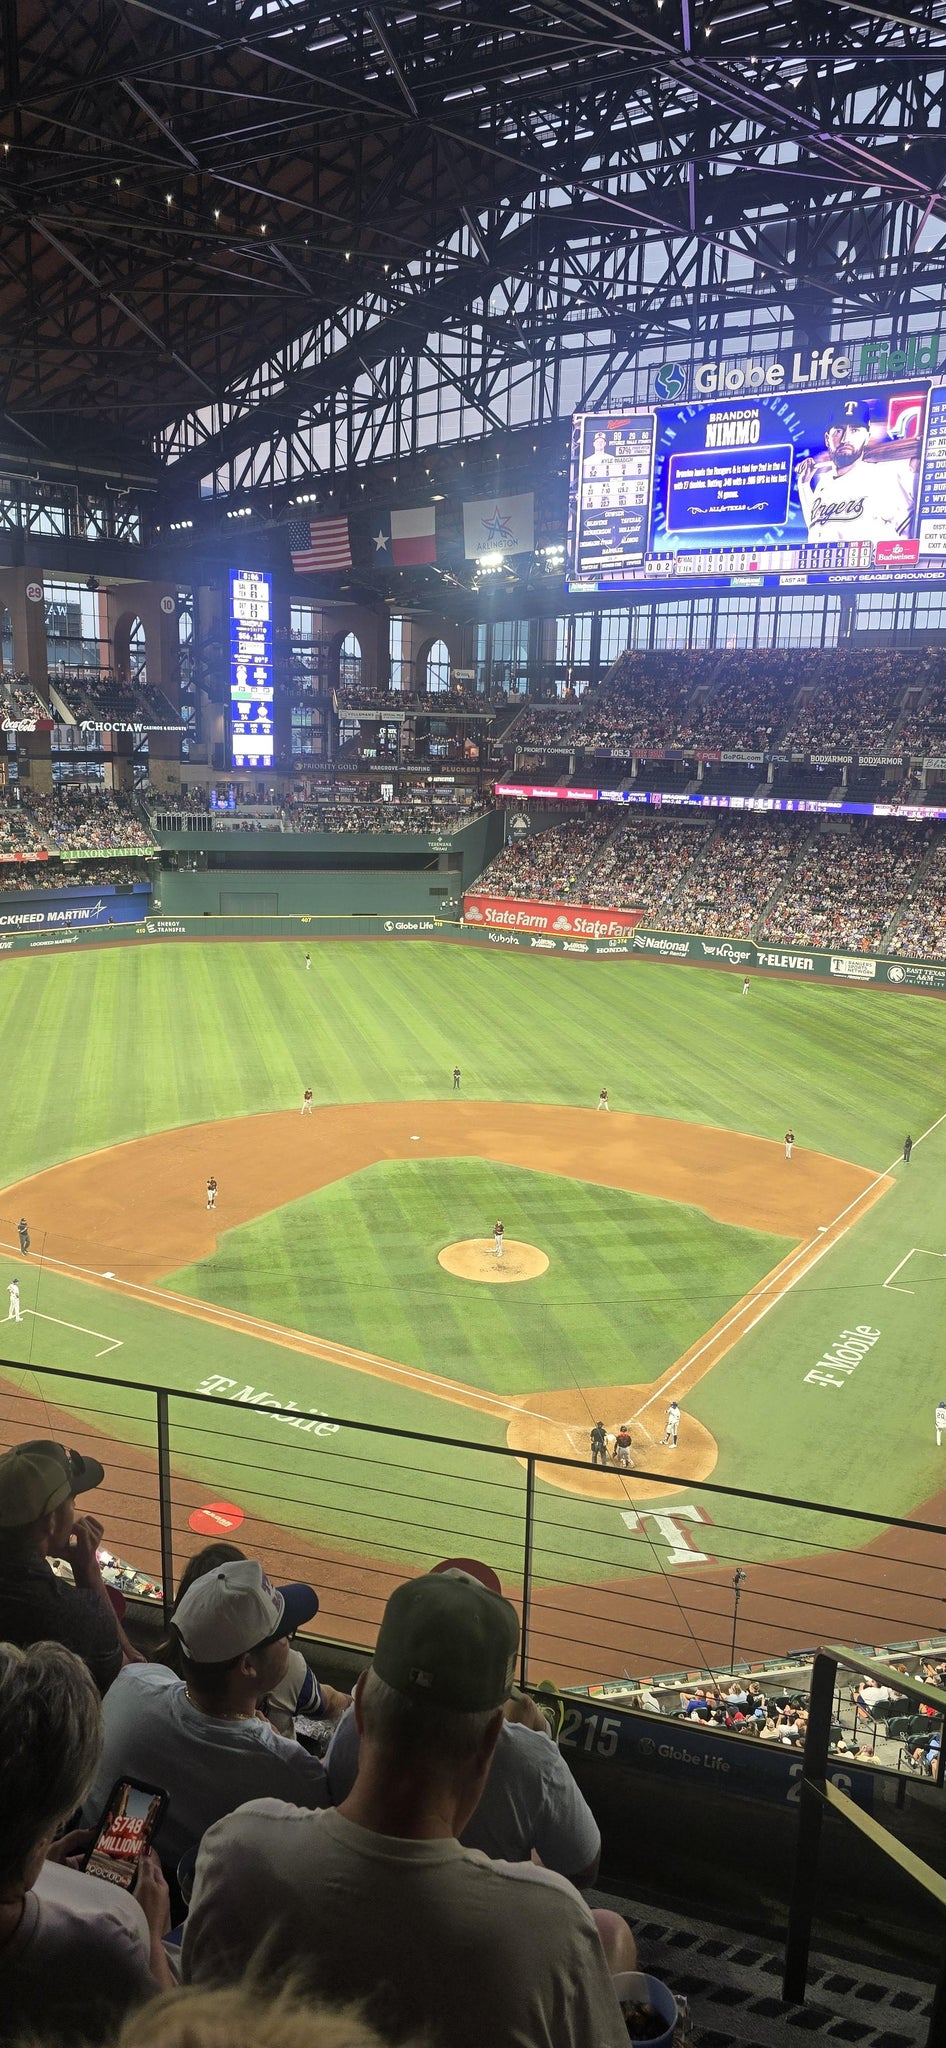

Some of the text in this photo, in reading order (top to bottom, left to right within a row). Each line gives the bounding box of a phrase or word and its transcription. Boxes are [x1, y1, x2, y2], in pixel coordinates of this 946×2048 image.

[694, 335, 939, 393] Globe Life Field
[709, 409, 759, 422] BRANDON
[705, 419, 760, 448] NIMMO
[477, 539, 519, 551] ARLINGTON
[878, 552, 916, 562] Budweiser
[894, 572, 946, 580] GROUNDED
[28, 587, 42, 598] 29
[162, 599, 172, 610] 10
[2, 719, 36, 732] Coca-Cola
[86, 720, 143, 732] CHOCTAW
[610, 750, 630, 758] 105.3
[723, 754, 762, 762] GoPGL.com
[772, 755, 790, 763] PGL
[810, 754, 853, 764] BODYARMOR
[858, 756, 902, 766] BODYARMOR
[70, 847, 152, 858] LUXOR STAFFING
[47, 910, 90, 922] MARTIN
[395, 922, 434, 930] Globe Life
[488, 932, 520, 945] Kubota
[596, 946, 628, 954] HONDA
[645, 938, 690, 952] National
[716, 944, 752, 964] Kroger
[560, 1708, 622, 1758] 215
[658, 1744, 731, 1773] Globe Life
[112, 1816, 144, 1834] $748
[98, 1836, 142, 1854] MILLION!
